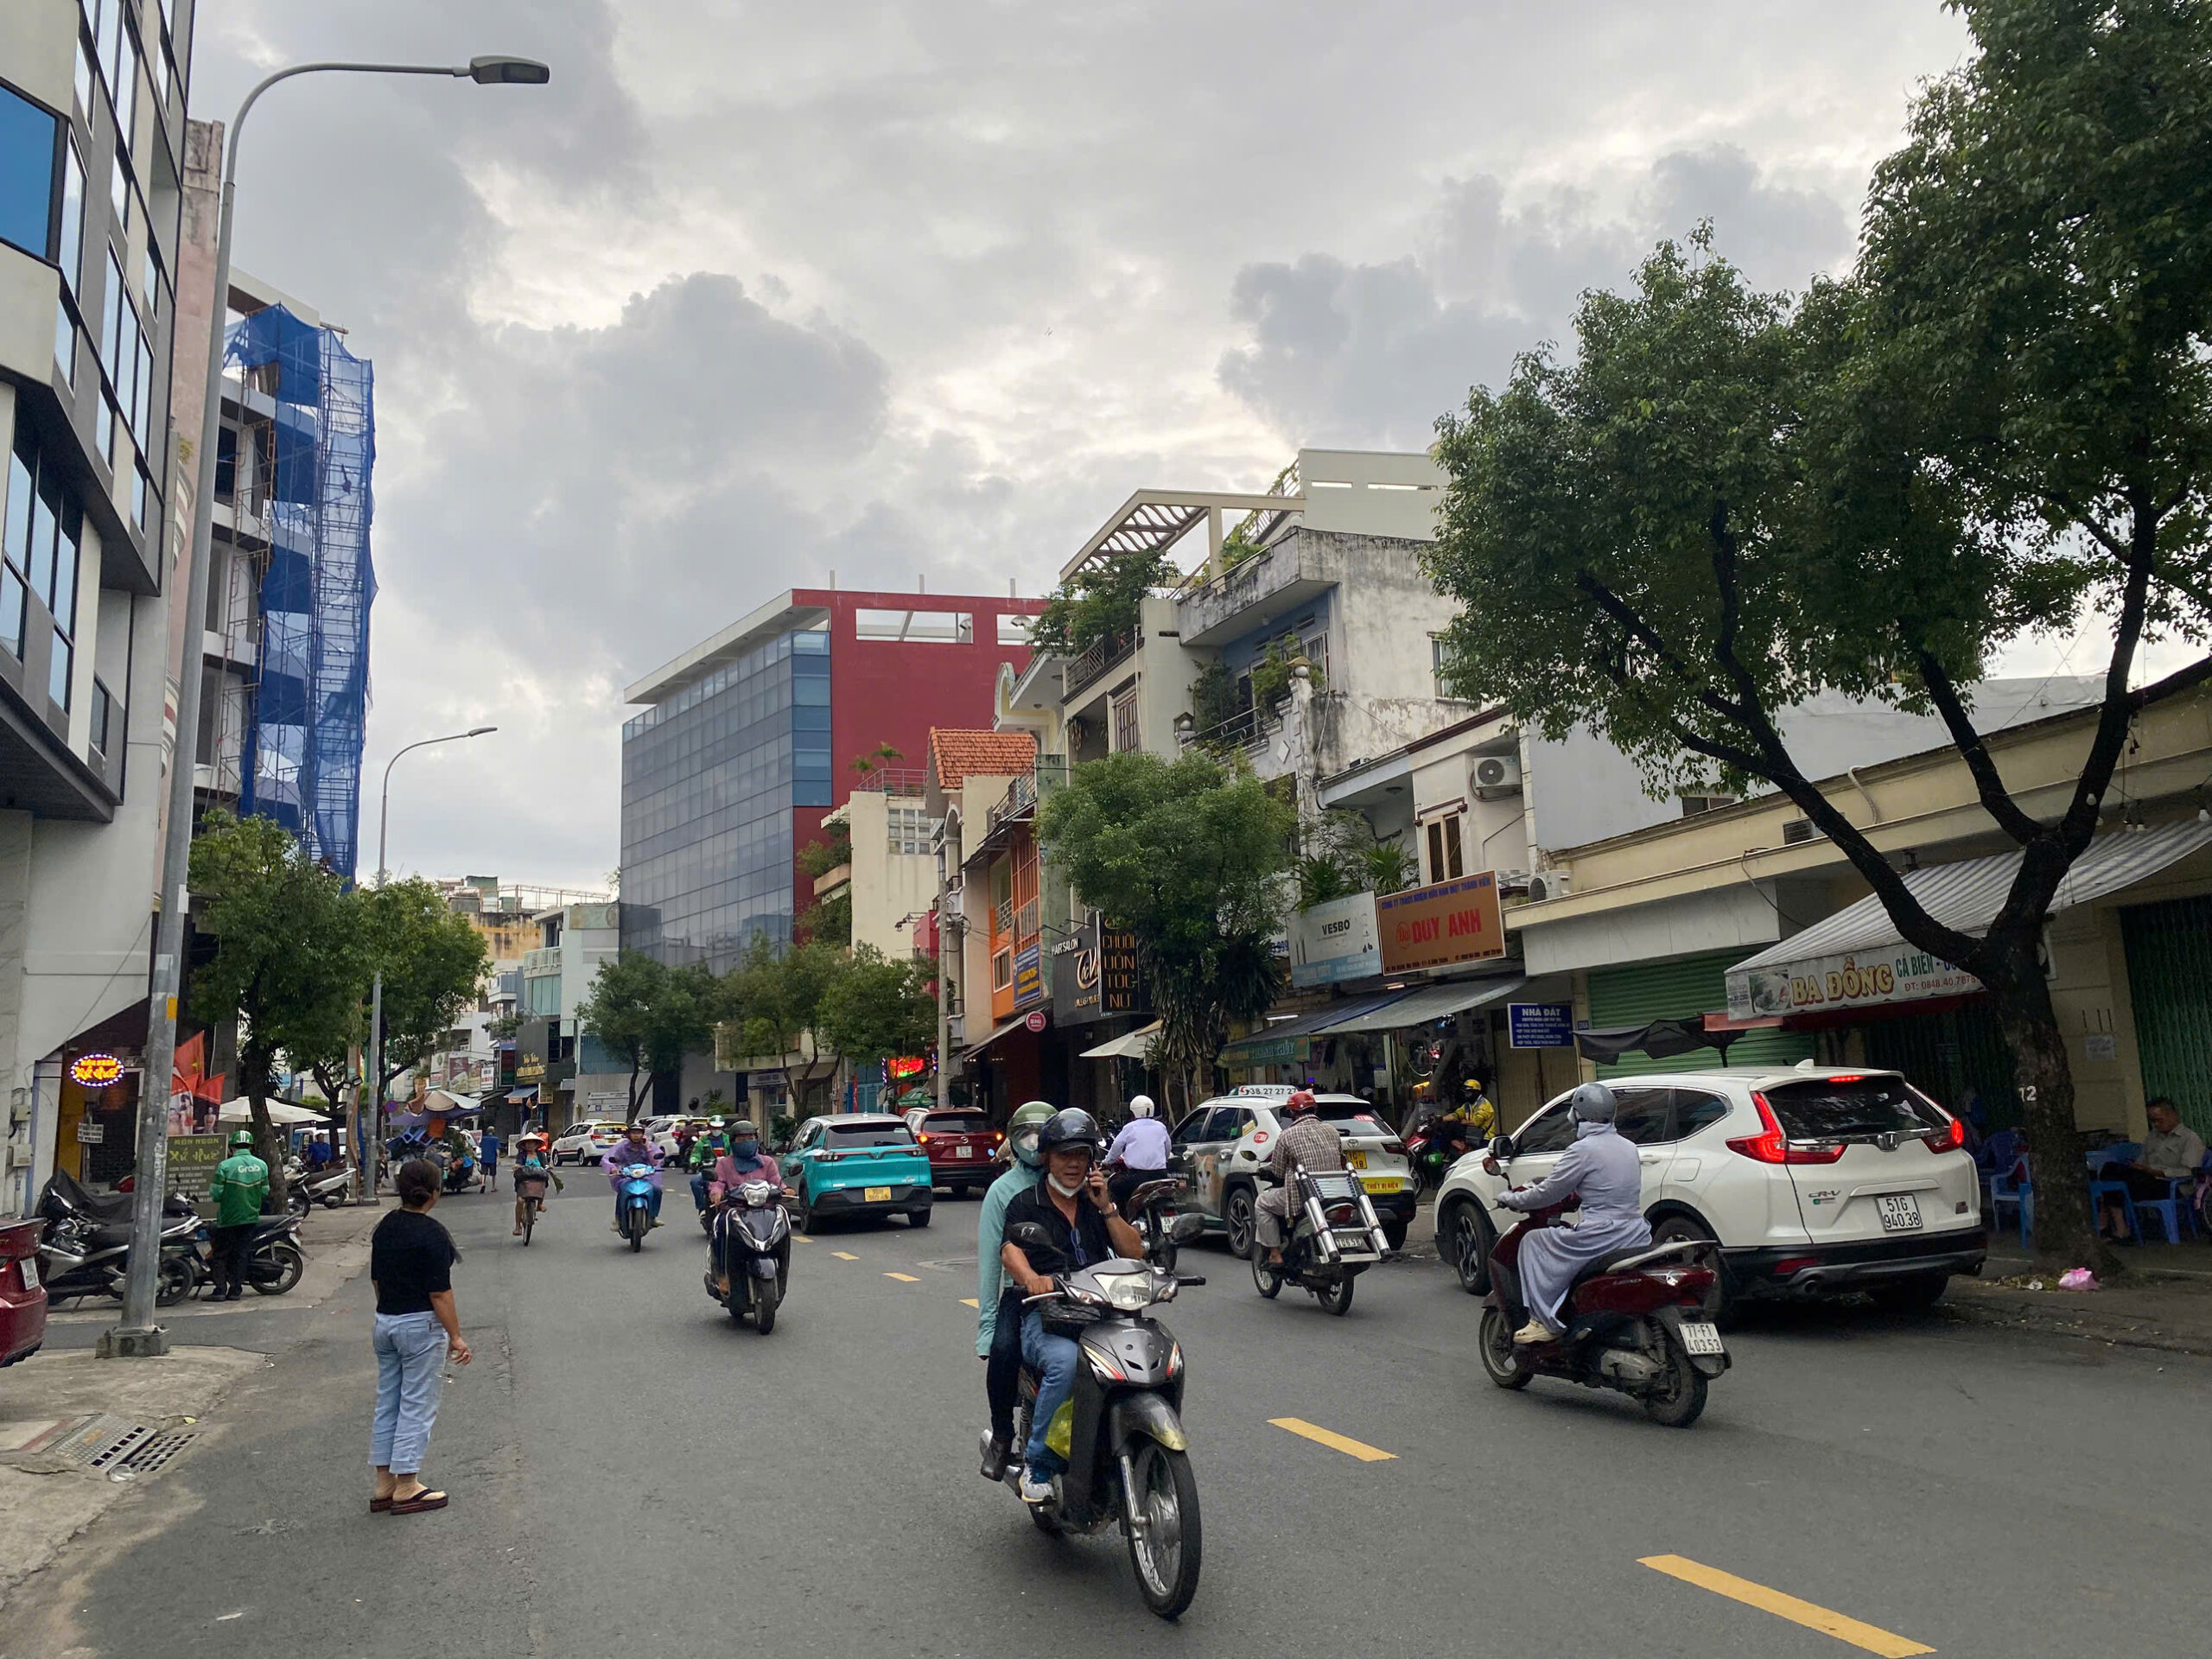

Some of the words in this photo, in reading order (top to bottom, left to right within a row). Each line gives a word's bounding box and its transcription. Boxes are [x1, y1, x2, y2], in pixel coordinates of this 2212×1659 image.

[1322, 919, 1350, 935] VESBO
[1412, 917, 1440, 944] DUY
[1448, 908, 1482, 938] ANH
[1896, 954, 1910, 977] CÁ
[1790, 976, 1824, 1006] BA
[1826, 956, 1894, 1001] ĐỒNG
[1522, 1007, 1541, 1016] NHÀ
[1542, 1007, 1560, 1016] ĐẤT
[238, 1165, 261, 1173] Grab
[1886, 1198, 1908, 1211] 51G
[1884, 1212, 1920, 1228] 940.38
[1686, 1325, 1713, 1338] 77-F1
